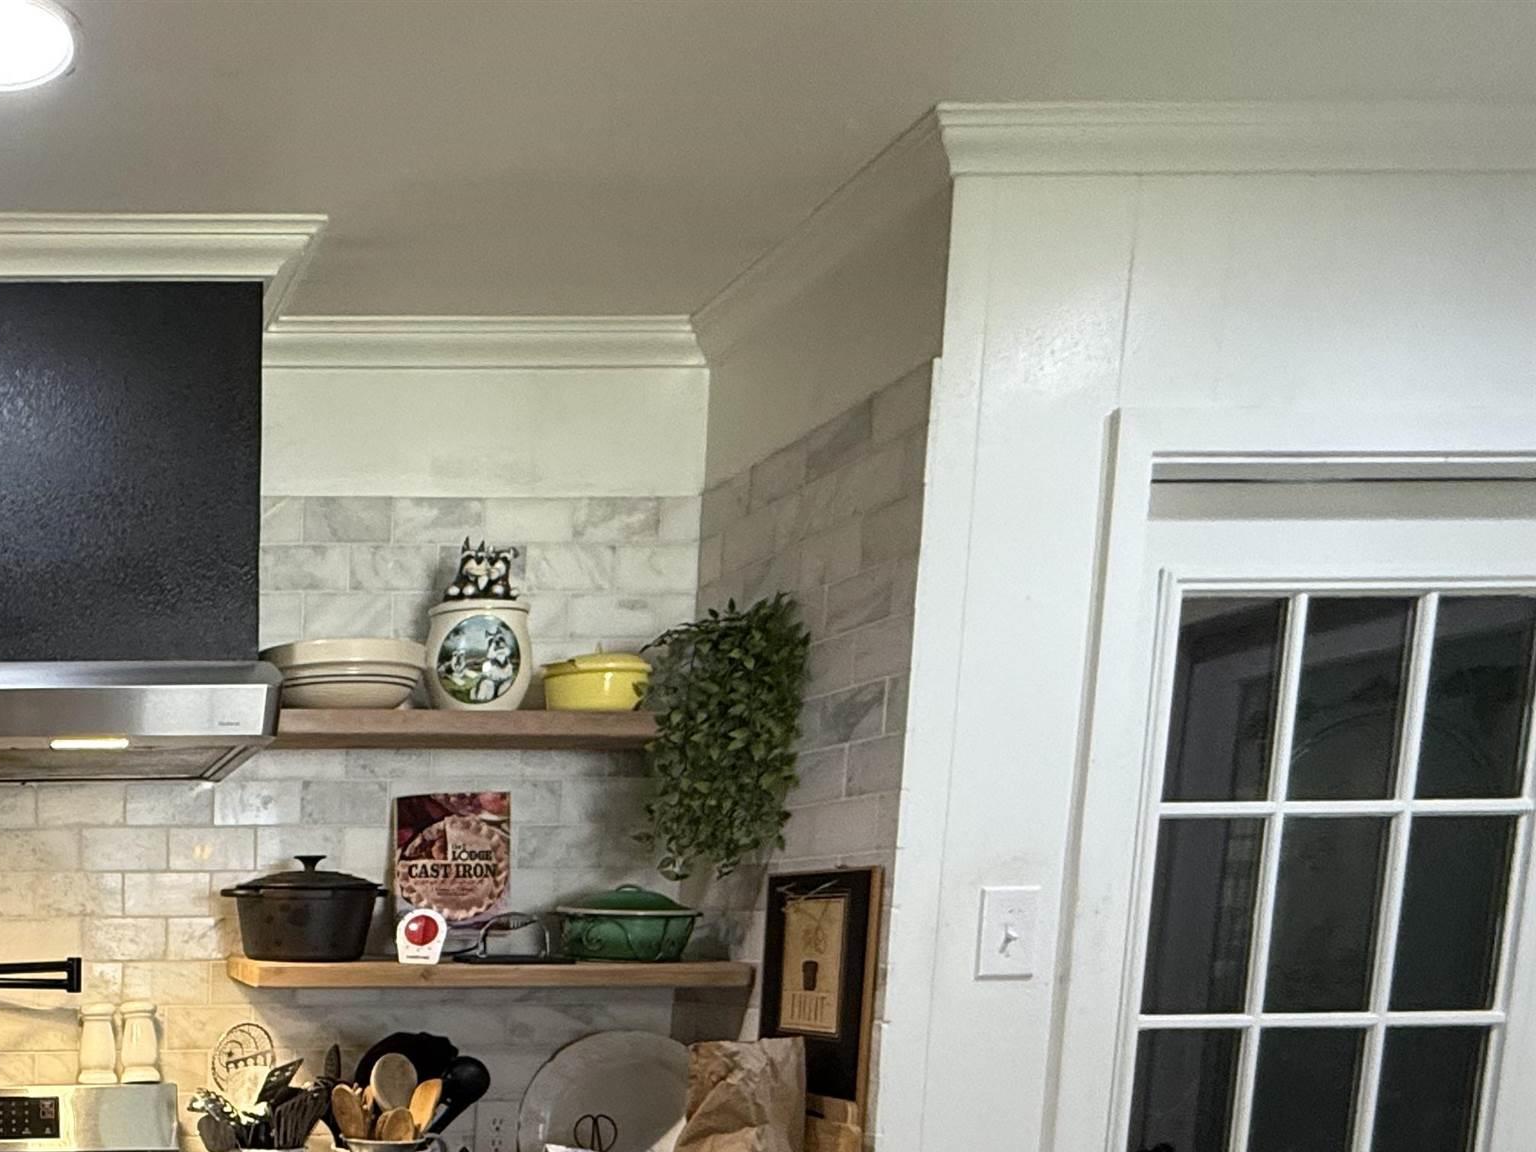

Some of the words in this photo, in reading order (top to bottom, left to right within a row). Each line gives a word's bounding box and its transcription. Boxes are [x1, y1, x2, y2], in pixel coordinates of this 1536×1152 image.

[452, 849, 492, 861] LODGE
[408, 863, 450, 879] CAST
[453, 863, 498, 879] IRON
